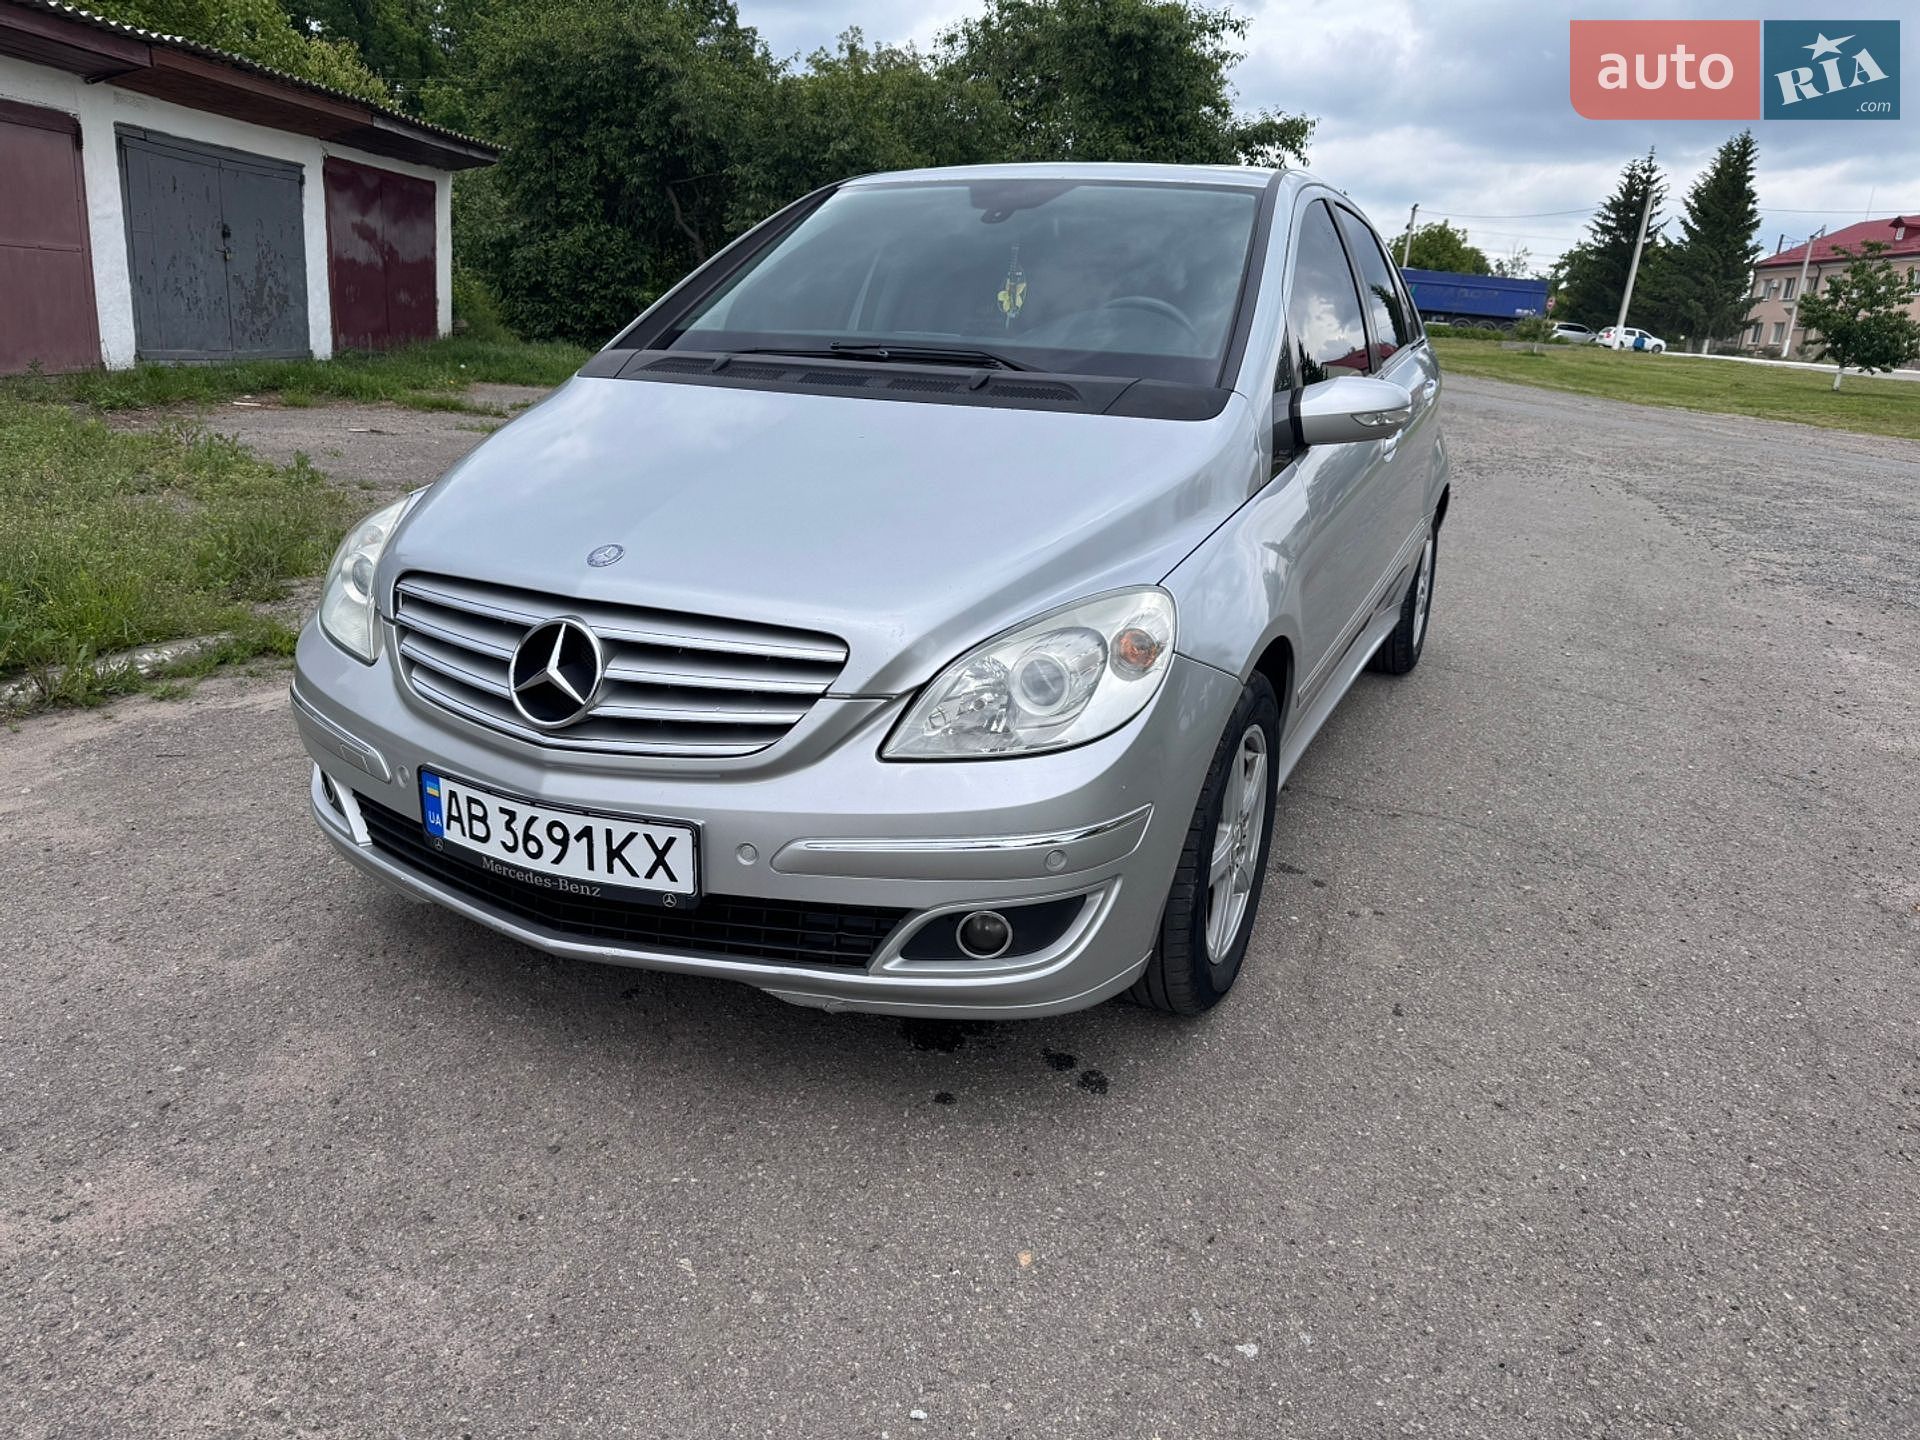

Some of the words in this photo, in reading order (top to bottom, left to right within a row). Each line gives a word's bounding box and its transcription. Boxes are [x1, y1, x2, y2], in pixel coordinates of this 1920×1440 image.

[428, 810, 442, 827] UA
[446, 789, 491, 844] AB
[481, 855, 601, 898] Mercedes-Benz
